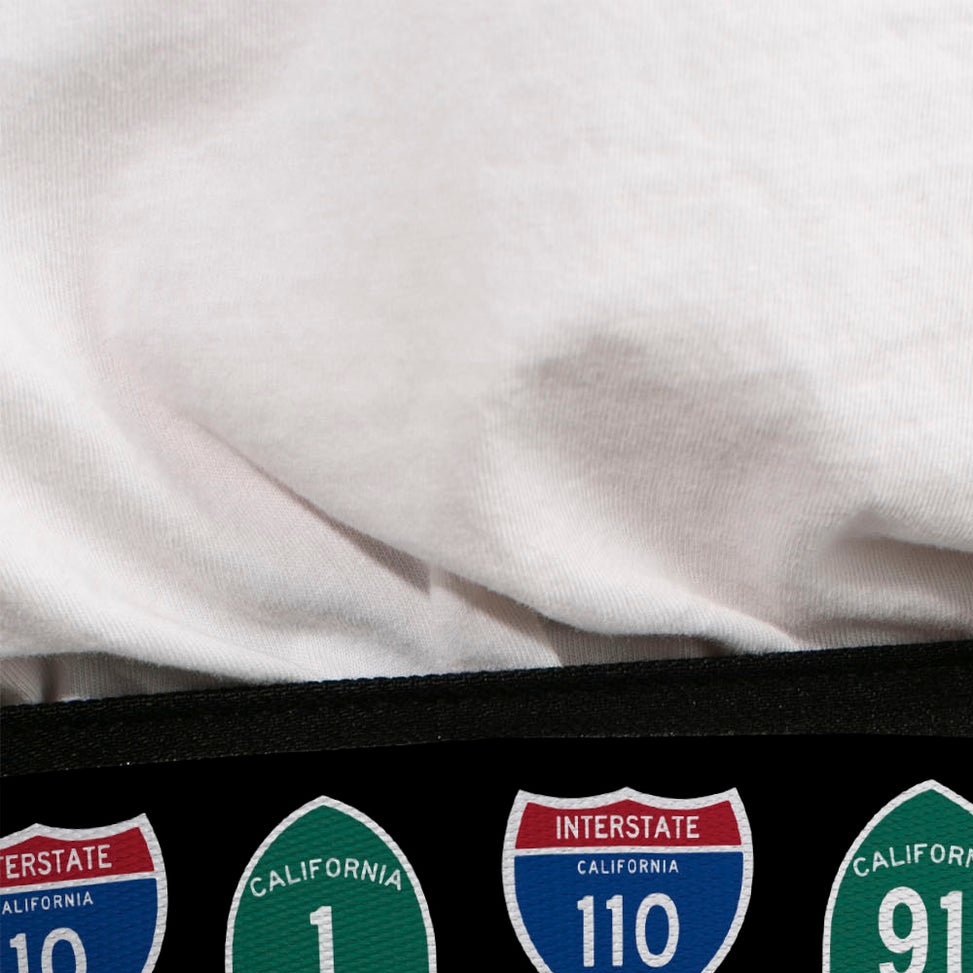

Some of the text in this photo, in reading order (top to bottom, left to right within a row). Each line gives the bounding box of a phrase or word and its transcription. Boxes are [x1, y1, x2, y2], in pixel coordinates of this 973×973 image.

[556, 814, 700, 840] INTERSTATE
[0, 844, 112, 879] ERSTATE
[250, 858, 402, 898] CALIFORNIA
[577, 859, 679, 875] CALIFORNIA
[576, 892, 680, 968] 110
